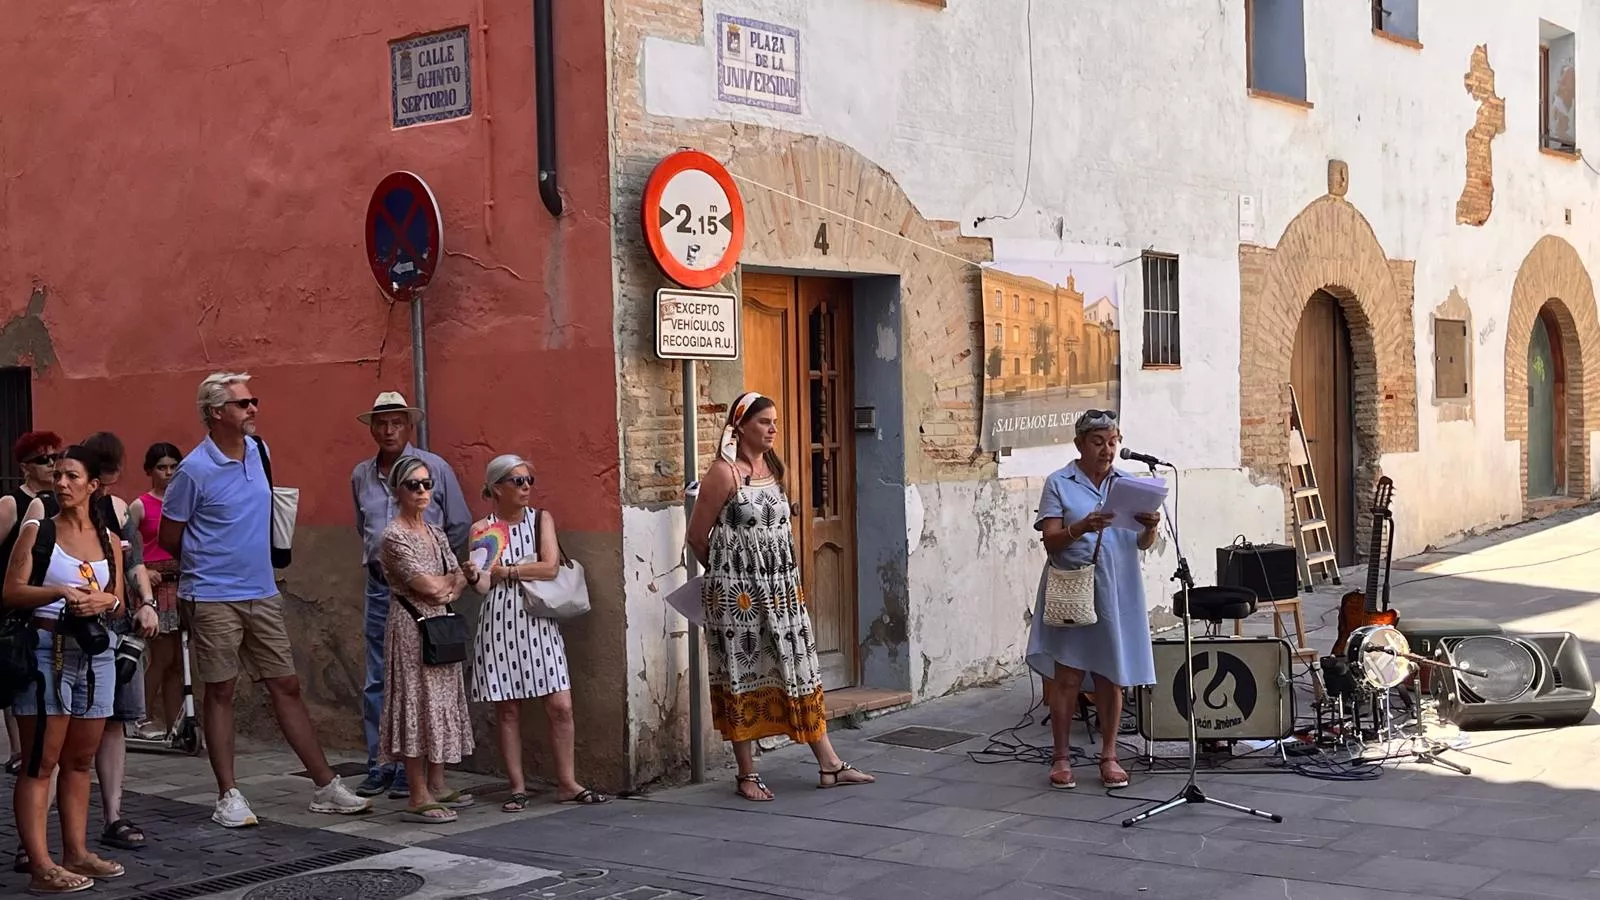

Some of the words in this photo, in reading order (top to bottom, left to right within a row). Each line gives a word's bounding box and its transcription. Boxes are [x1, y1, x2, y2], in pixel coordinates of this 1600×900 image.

[750, 31, 786, 55] PLAZA
[418, 45, 455, 68] CALLE
[755, 53, 769, 68] DE
[771, 55, 785, 72] LA
[416, 65, 461, 90] QUINTO
[722, 64, 799, 98] UNIVERSIDAD
[401, 88, 457, 114] SERTORIO
[814, 222, 830, 256] 4
[675, 302, 720, 316] EXCEPTO
[671, 316, 725, 333] VEHÍCULOS
[662, 334, 713, 348] RECOGIDA
[714, 336, 733, 349] R.U.
[991, 414, 1047, 436] ¡SALVEMOS
[1047, 413, 1059, 427] EL
